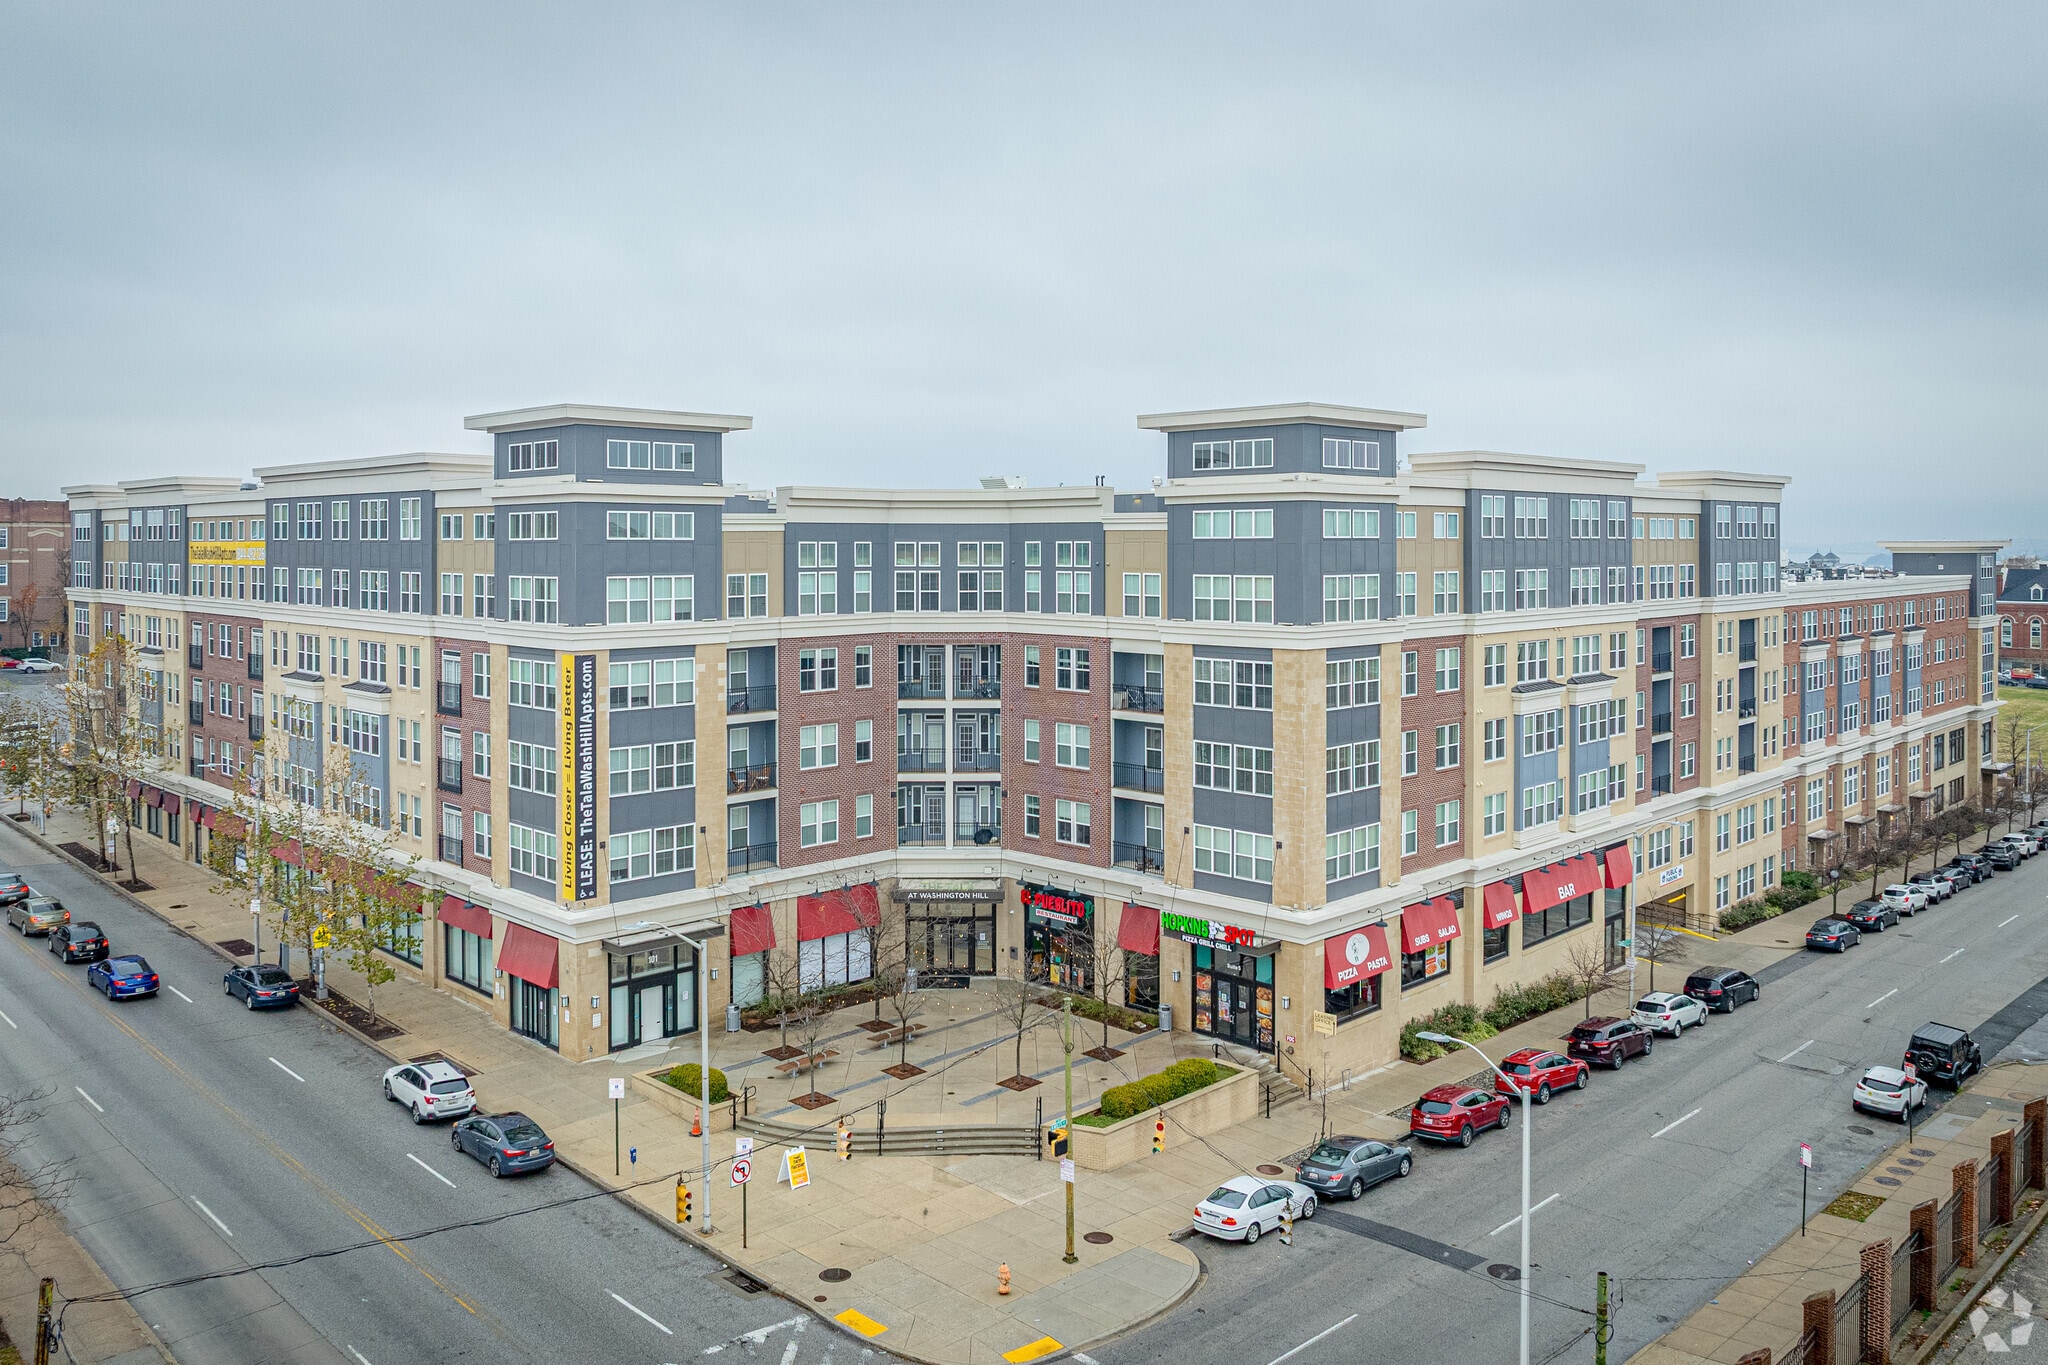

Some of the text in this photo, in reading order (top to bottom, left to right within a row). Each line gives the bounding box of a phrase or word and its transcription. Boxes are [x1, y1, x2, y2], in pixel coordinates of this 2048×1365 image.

[564, 667, 572, 717] Better
[564, 721, 573, 769] Living
[579, 660, 595, 887] LEASE: TheTalaWashHillApts.com
[564, 787, 572, 837] Closer
[564, 841, 573, 889] Living
[1666, 867, 1678, 877] PUBLIC
[1557, 882, 1576, 900] BAR
[1020, 889, 1085, 919] EL PUEBLITO
[1036, 909, 1076, 923] RESTAURANT
[1495, 908, 1513, 922] WINGS
[1161, 911, 1255, 948] HOPKINS SPOT
[1414, 924, 1457, 947] SUBS SALAD
[1181, 934, 1233, 952] PIZZA GRILL CHILL
[648, 954, 658, 964] 101
[1337, 956, 1389, 982] PIZZA PASTA
[1314, 1017, 1331, 1026] OFFICE
